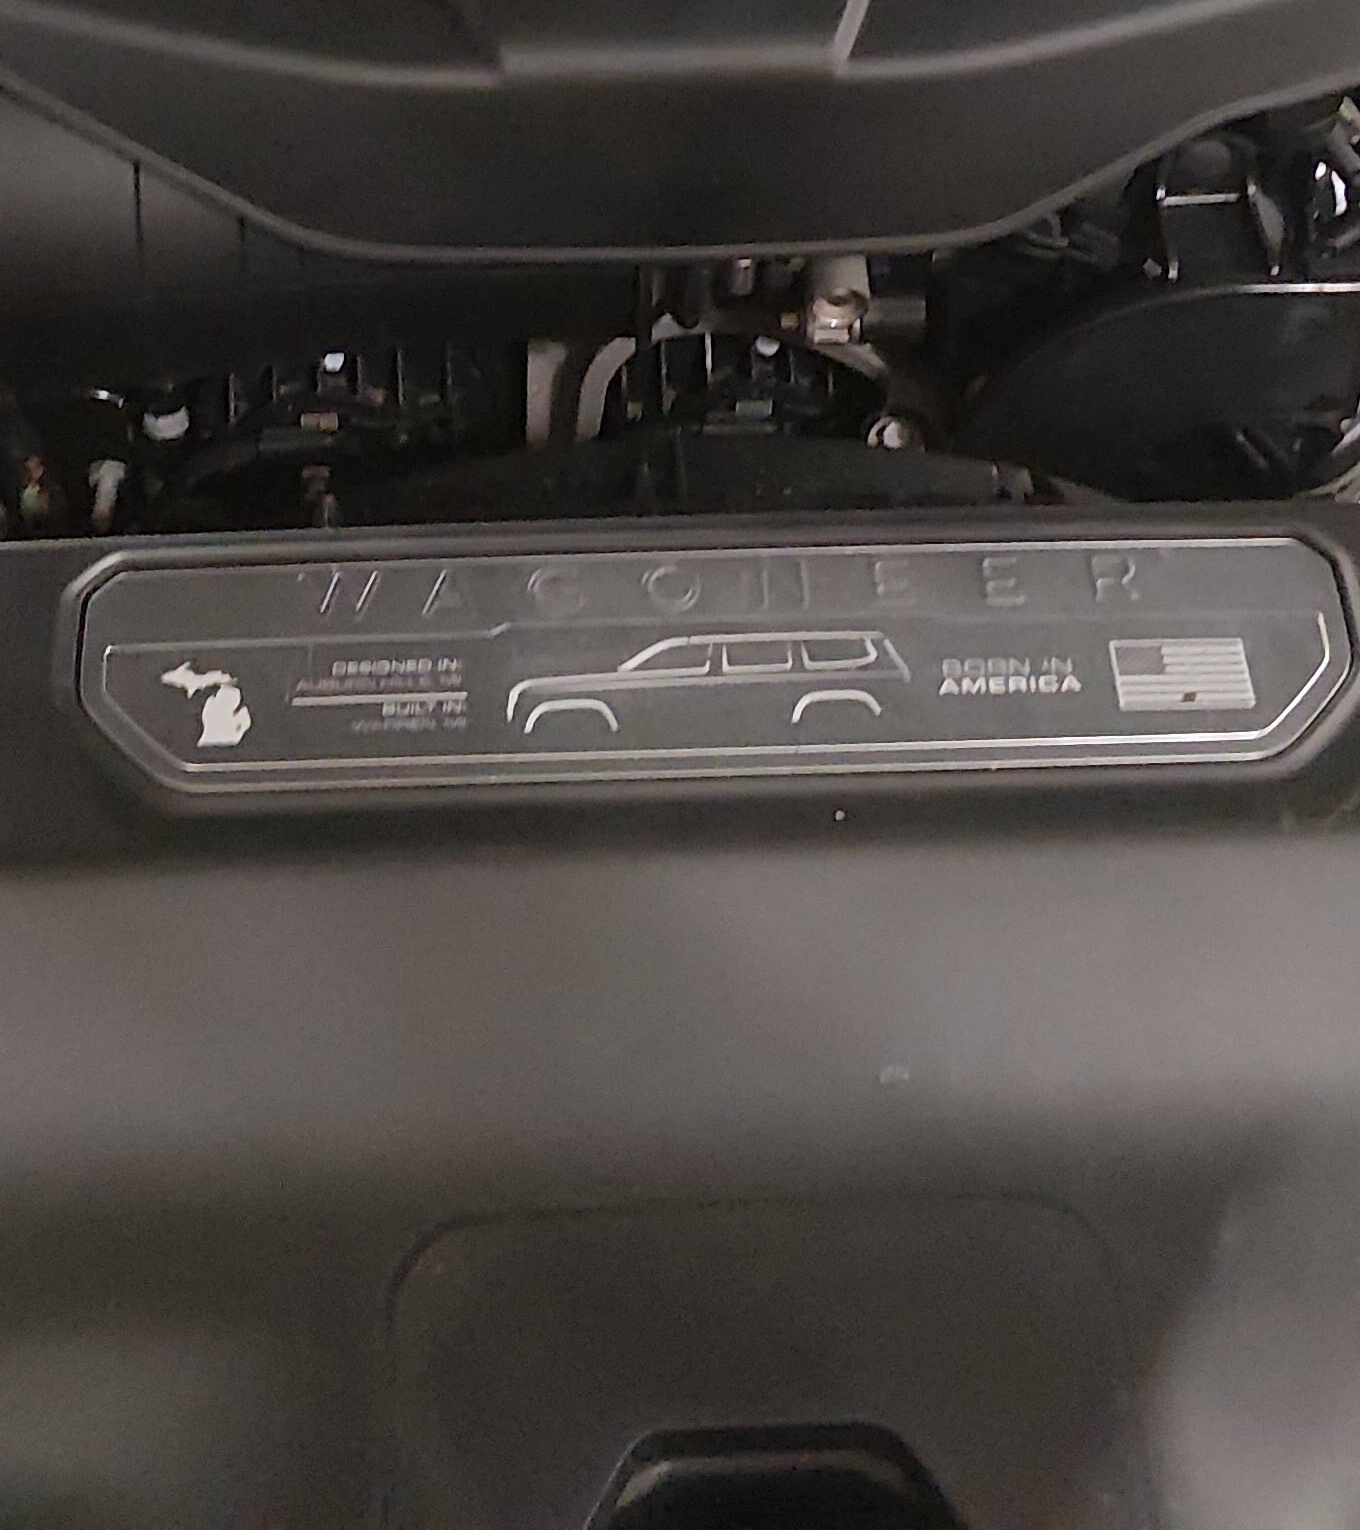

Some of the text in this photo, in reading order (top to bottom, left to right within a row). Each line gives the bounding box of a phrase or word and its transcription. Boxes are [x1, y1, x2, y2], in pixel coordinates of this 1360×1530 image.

[298, 550, 1142, 618] WAGONEER
[941, 655, 1074, 678] BORN IN
[938, 674, 1084, 697] AMERICA
